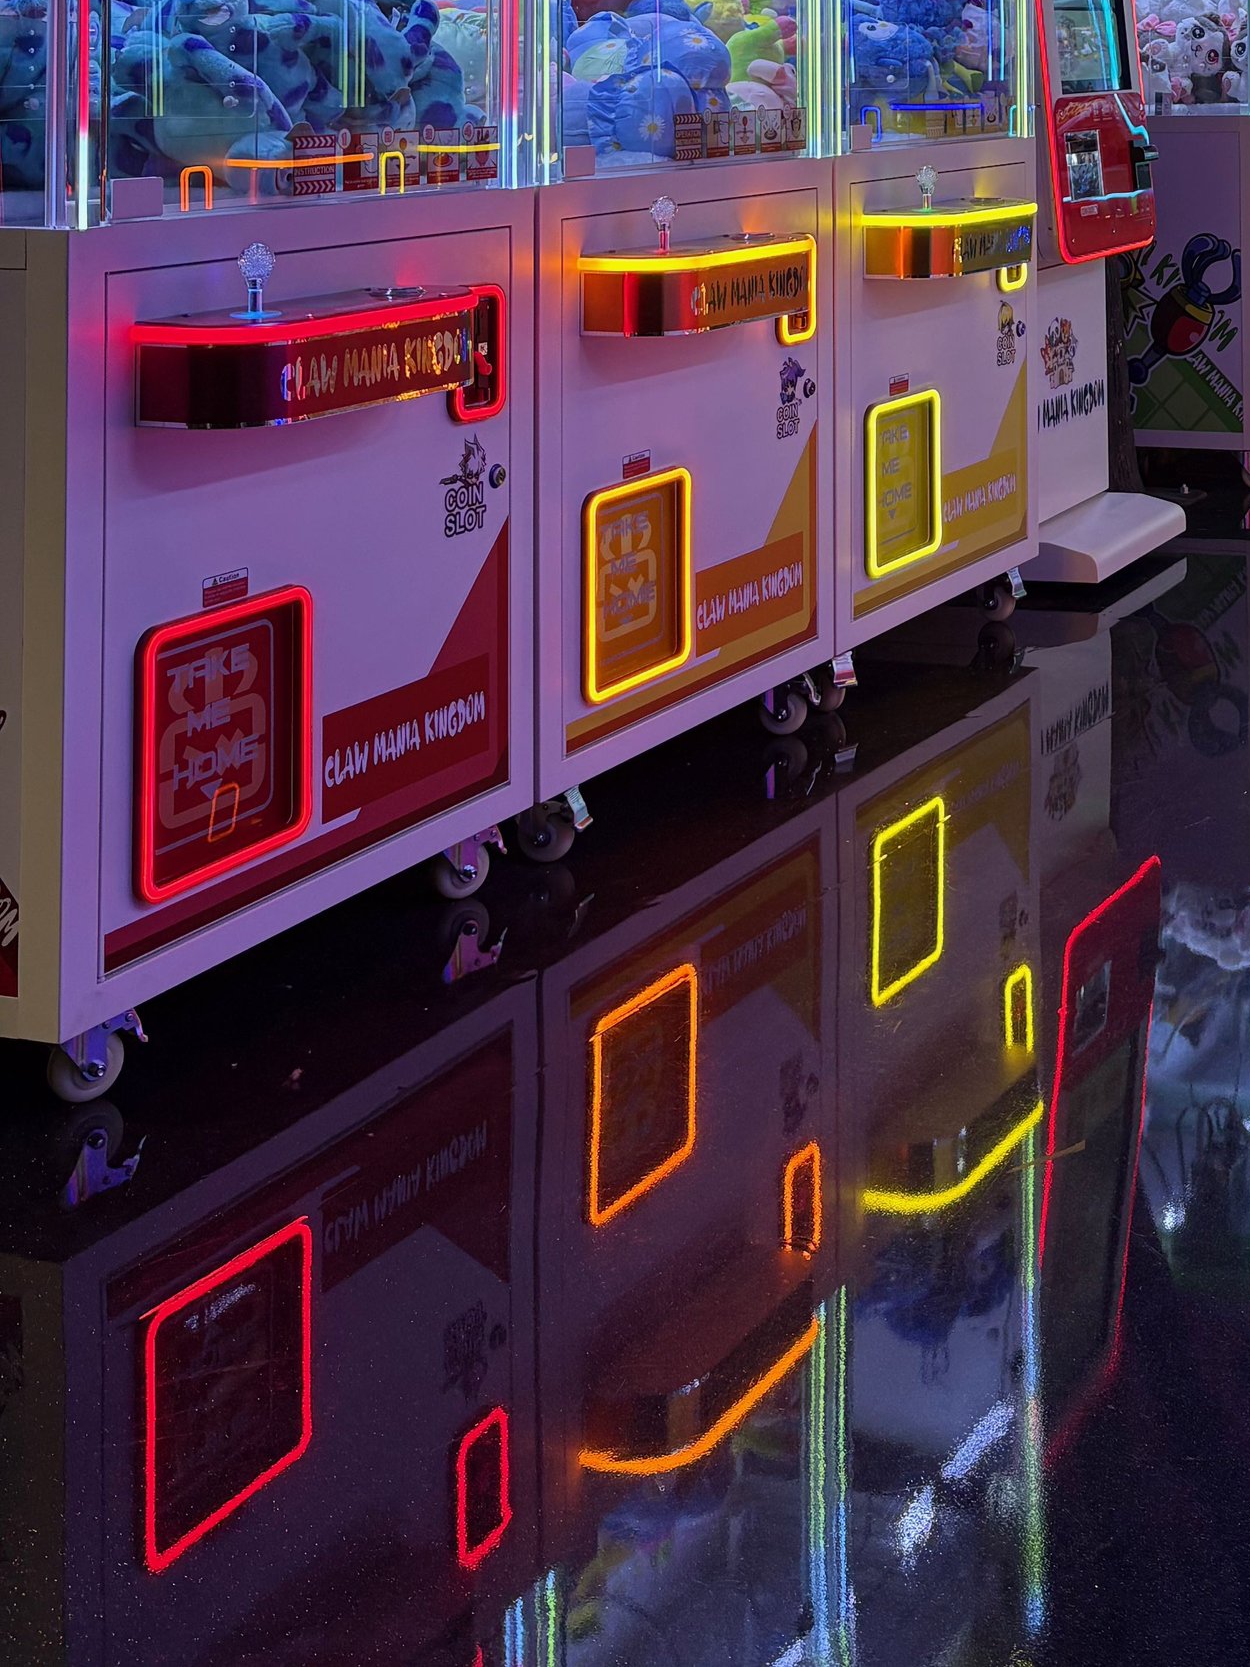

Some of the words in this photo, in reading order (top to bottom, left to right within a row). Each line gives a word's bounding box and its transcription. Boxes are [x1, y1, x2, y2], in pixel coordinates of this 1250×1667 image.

[731, 273, 766, 307] MANIA
[281, 352, 339, 402] CLAW
[343, 342, 400, 388] MANIA
[1204, 367, 1237, 406] MANIA
[776, 401, 798, 423] COIN
[1042, 394, 1068, 429] MANIA
[1070, 379, 1105, 418] KINGDOM
[776, 418, 800, 440] SLOT
[444, 482, 483, 513] COIN
[444, 505, 487, 537] SLOT
[218, 572, 240, 584] Caution
[696, 595, 726, 630] CLAW
[728, 584, 760, 615] MANIA
[761, 560, 803, 602] KINGDOM
[167, 643, 251, 692] TAKE
[186, 697, 232, 737] ME
[324, 740, 369, 788] CLAW
[373, 718, 421, 766] MANIA
[424, 690, 486, 745] KINGDOM
[173, 734, 259, 792] HOME
